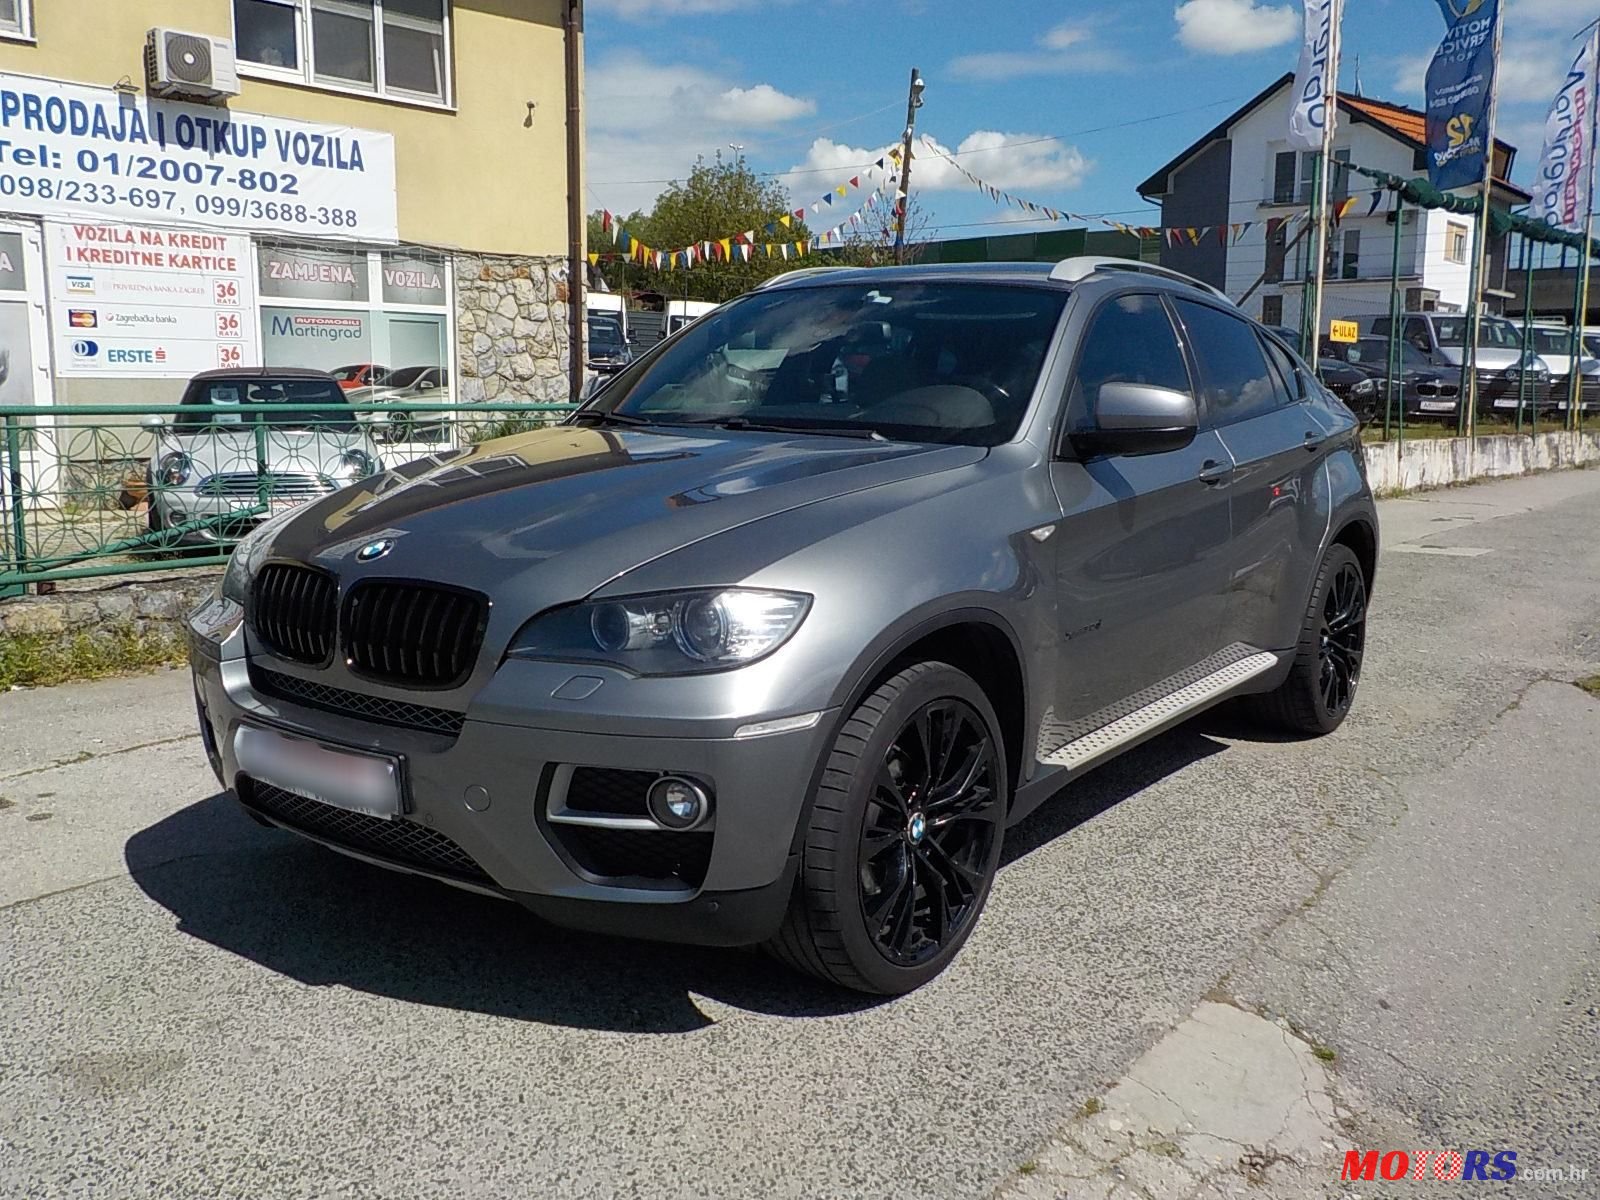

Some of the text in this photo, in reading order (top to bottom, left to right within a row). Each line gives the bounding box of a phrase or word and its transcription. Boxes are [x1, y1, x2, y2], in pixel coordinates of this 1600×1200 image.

[1, 90, 365, 172] PRODAJA I OTKUP VOZILA
[77, 149, 299, 195] 01/2007-802
[0, 174, 358, 228] 098/233-697, 099/3688-388
[74, 226, 227, 250] VOZILA NA KREDIT
[66, 247, 237, 271] I KREDITNE KARTICE
[269, 261, 442, 289] ZAMJENA VOZILA
[71, 281, 91, 289] VISA
[154, 284, 178, 293] BANKA
[217, 282, 237, 298] 36
[116, 313, 177, 324] Zagrebačka banka
[218, 314, 239, 330] 36
[296, 317, 360, 326] AUTOMOBILI
[272, 315, 362, 341] Martingrad
[1340, 325, 1356, 338] ULAZ
[107, 349, 153, 363] ERSTE
[220, 346, 240, 363] 36
